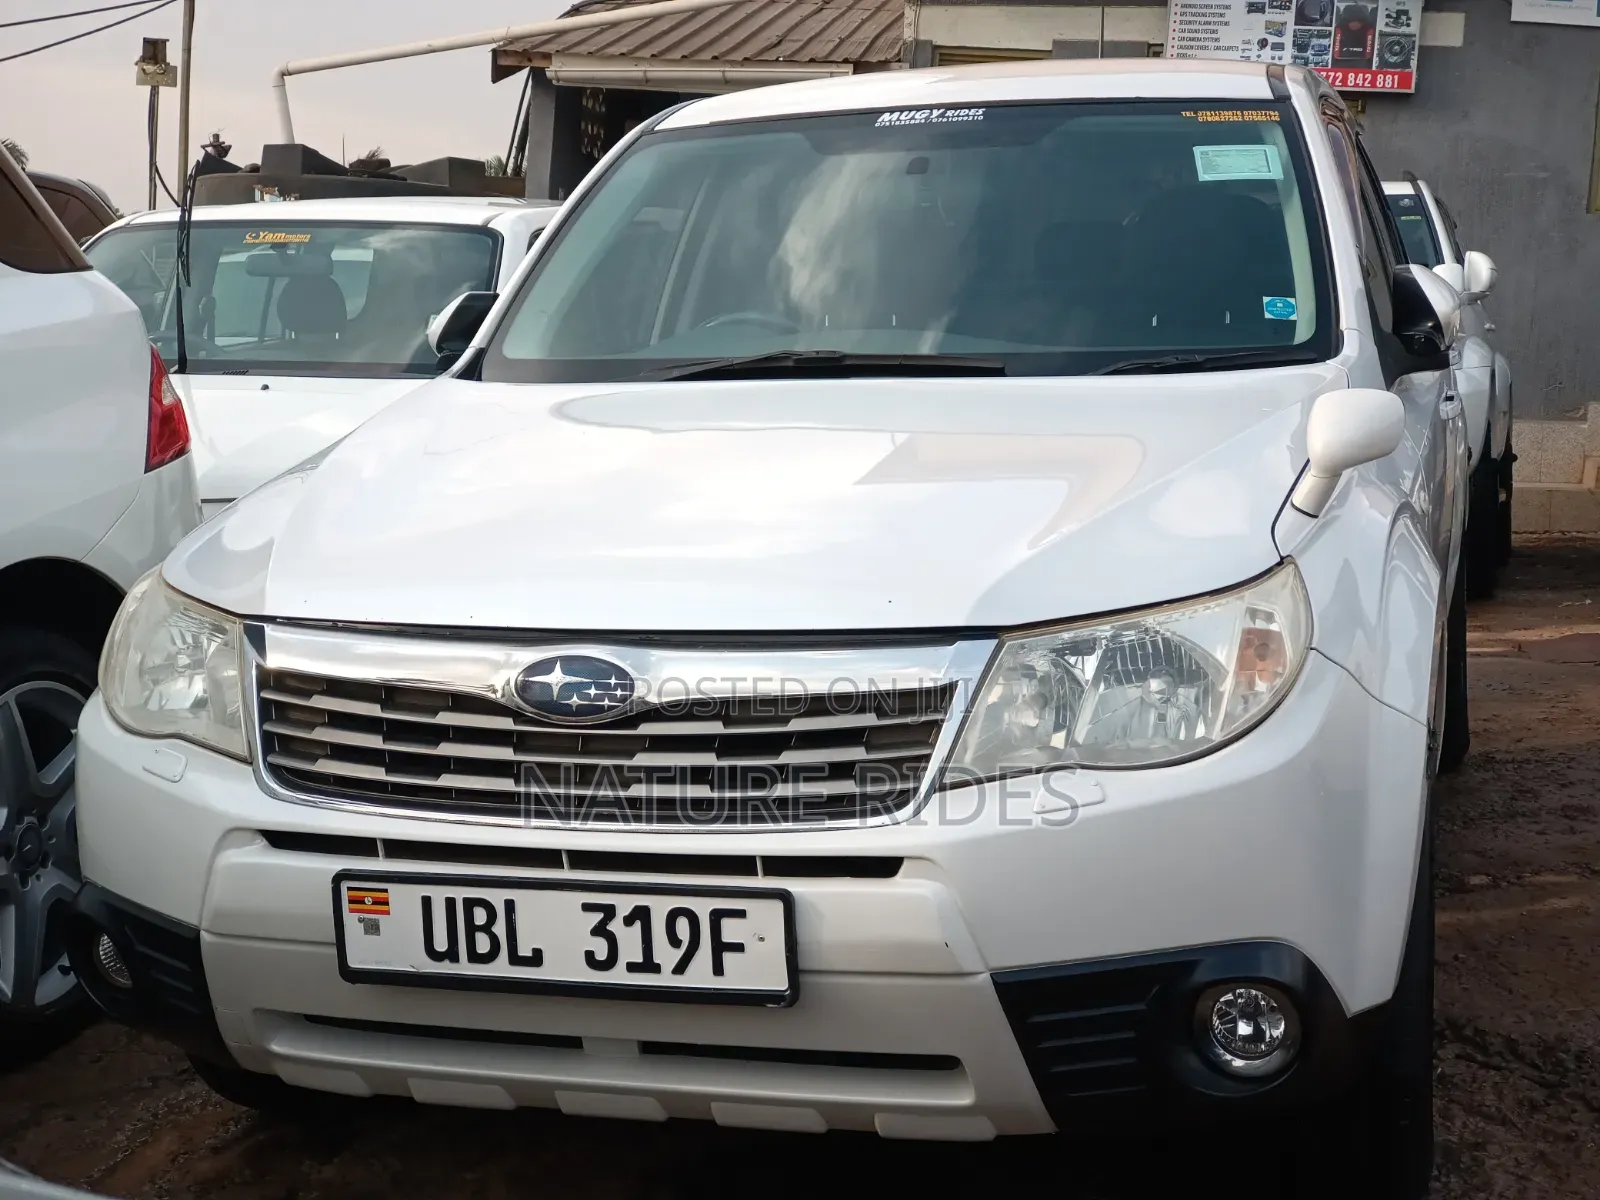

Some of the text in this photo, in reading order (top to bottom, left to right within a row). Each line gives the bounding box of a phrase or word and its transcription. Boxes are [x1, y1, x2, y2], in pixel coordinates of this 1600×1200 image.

[1348, 73, 1372, 87] 842
[1376, 75, 1398, 88] 881
[877, 109, 946, 122] MUGY
[259, 231, 285, 239] Yam
[420, 895, 748, 977] UBL 319F
